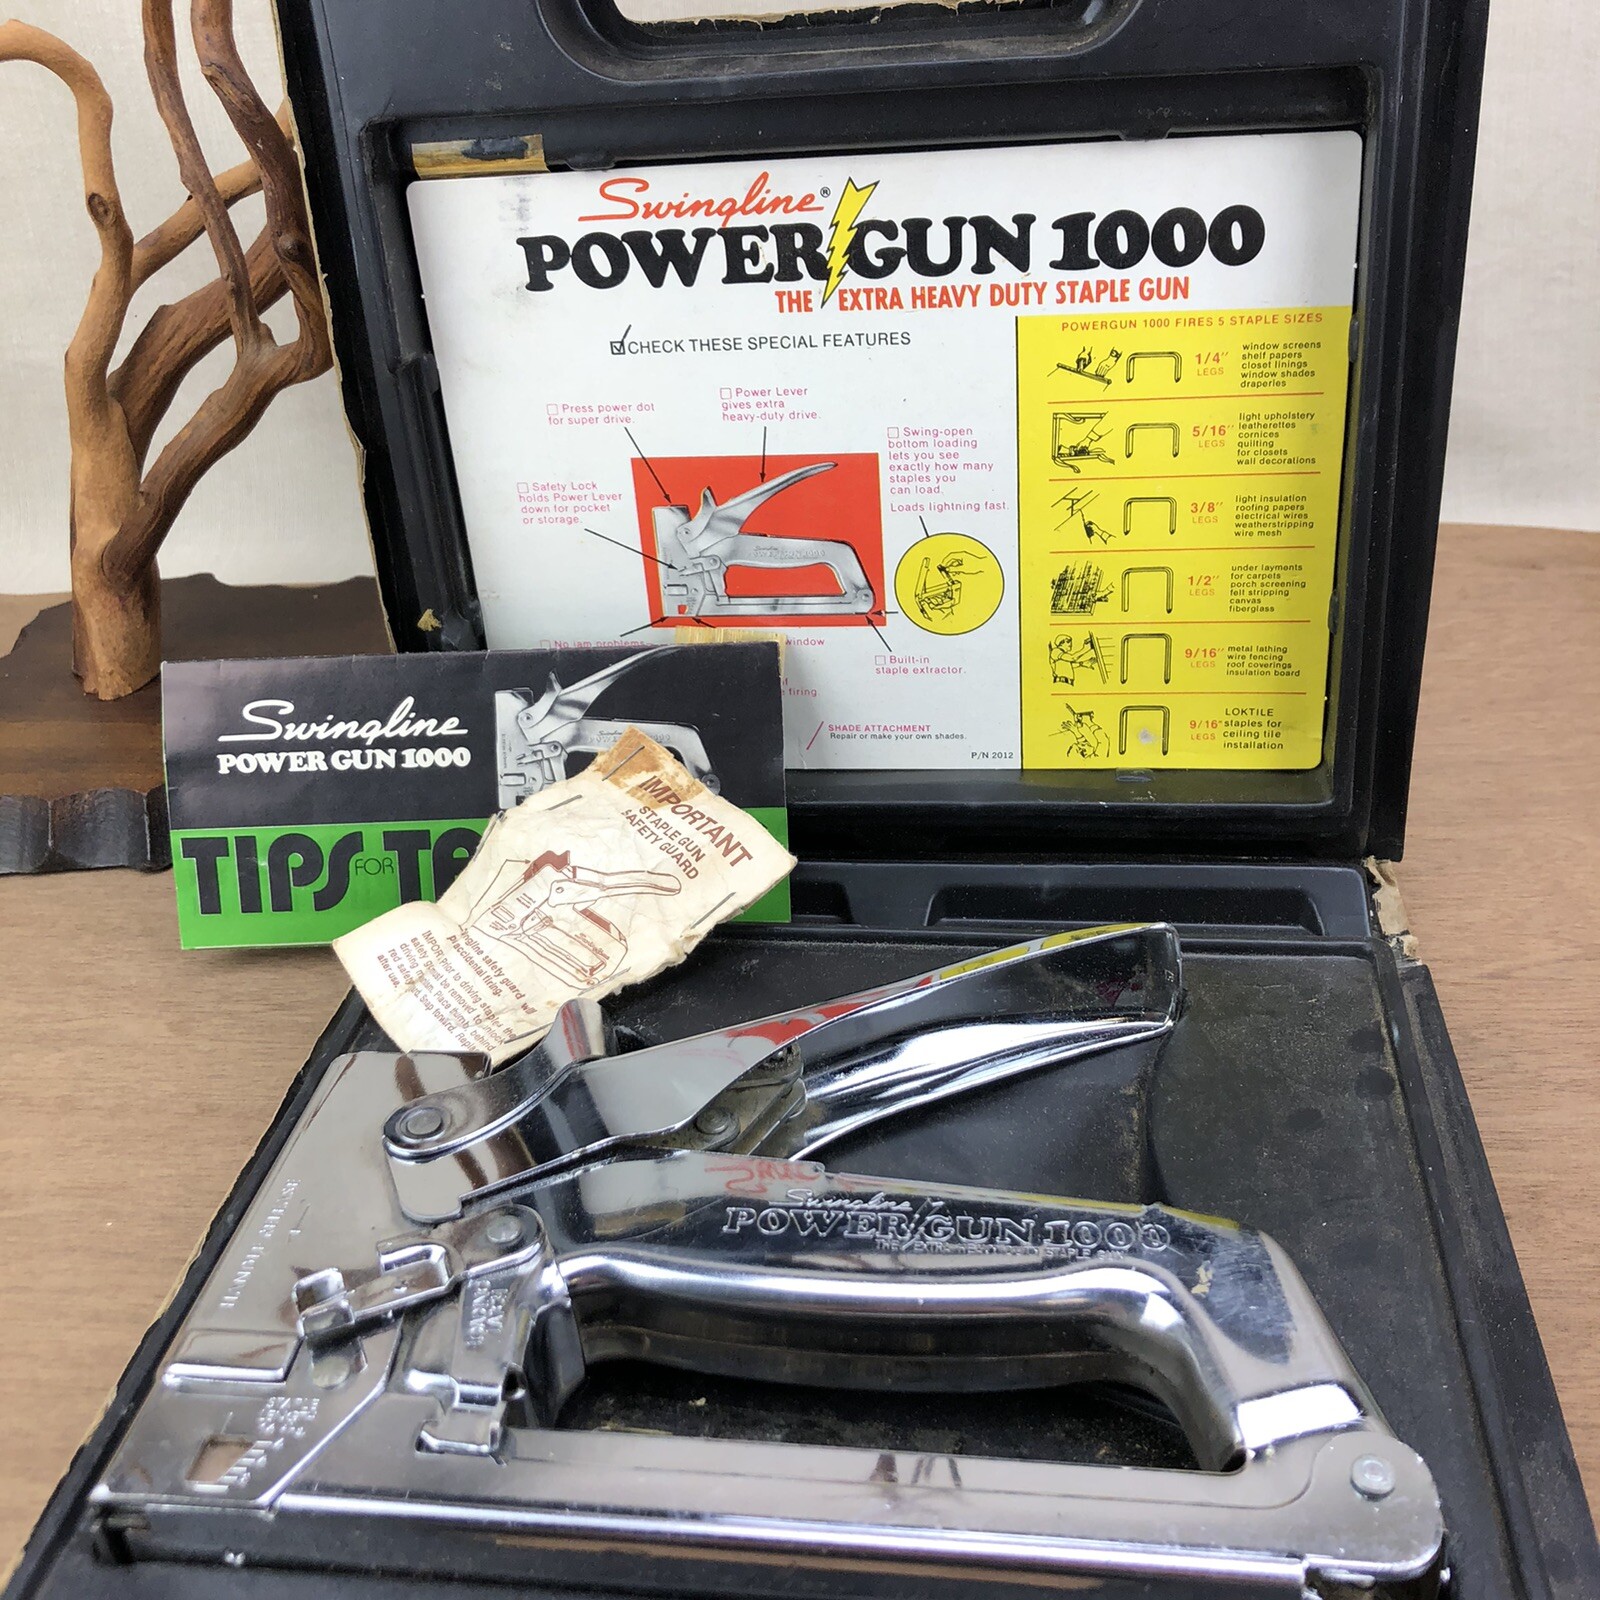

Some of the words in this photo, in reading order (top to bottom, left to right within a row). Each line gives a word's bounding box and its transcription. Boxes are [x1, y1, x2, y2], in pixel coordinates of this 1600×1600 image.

[516, 222, 830, 291] POWER
[848, 214, 1036, 279] GUN
[1049, 205, 1265, 271] 1000
[775, 290, 813, 313] THE
[838, 287, 900, 311] EXTRA
[911, 285, 981, 309] HEAVY
[990, 282, 1047, 307] DUTY
[1056, 278, 1131, 304] STAPLE
[1139, 276, 1189, 300] GUN
[1062, 320, 1137, 332] POWERGUN
[1143, 318, 1170, 328] 1000
[1176, 317, 1213, 327] FIRES
[1218, 317, 1224, 326] 5
[1230, 314, 1279, 325] STAPLE
[1284, 313, 1323, 324] SIZES
[628, 340, 685, 354] CHECK
[689, 337, 743, 352] THESE
[748, 335, 818, 350] SPECIAL
[823, 332, 911, 347] FEATURES
[1242, 342, 1279, 350] window
[1283, 341, 1321, 349] screens
[1242, 351, 1266, 360] shelf
[1269, 351, 1302, 361] papers
[1241, 361, 1271, 369] closet
[1275, 360, 1308, 369] linings
[1197, 367, 1224, 376] LEGS
[1241, 371, 1277, 379] window
[1281, 369, 1315, 378] shades
[1240, 380, 1286, 388] draperies
[735, 388, 772, 398] Power
[776, 386, 808, 396] Lever
[562, 404, 594, 413] Press
[598, 403, 632, 413] power
[637, 402, 655, 411] dot
[722, 400, 751, 411] gives
[756, 399, 785, 409] extra
[548, 415, 563, 425] for
[568, 416, 599, 426] super
[722, 410, 784, 422] heavy-duty
[789, 410, 821, 420] drive.
[1239, 412, 1261, 421] light
[1264, 412, 1315, 421] upholstery
[1239, 421, 1296, 430] leatherettes
[903, 427, 973, 438] Swing-open
[1238, 430, 1279, 438] cornices
[888, 440, 929, 448] bottom
[934, 439, 978, 449] loading
[1199, 440, 1225, 448] LEGS
[1237, 440, 1274, 448] quilting
[888, 451, 909, 460] lets
[914, 452, 934, 461] you
[1237, 448, 1250, 456] for
[1253, 448, 1288, 456] closets
[1237, 457, 1256, 465] wall
[889, 462, 930, 472] exactly
[934, 462, 958, 470] how
[963, 462, 993, 472] many
[889, 474, 931, 484] staples
[935, 474, 956, 484] you
[532, 482, 567, 492] Safety
[571, 481, 598, 490] Lock
[890, 486, 911, 495] can
[519, 494, 549, 502] holds
[553, 493, 588, 502] Power
[592, 493, 622, 501] Lever
[1235, 495, 1257, 504] light
[521, 505, 550, 513] down
[554, 505, 568, 513] for
[573, 504, 611, 513] pocket
[890, 502, 925, 512] Loads
[929, 501, 980, 512] lightning
[1236, 504, 1269, 512] roofing
[1235, 520, 1314, 529] weatherstripping
[1261, 564, 1303, 572] layments
[1247, 572, 1281, 581] carpets
[1260, 580, 1306, 588] screening
[1248, 589, 1289, 597] stripping
[1229, 605, 1275, 613] fiberglass
[785, 638, 825, 646] window
[1256, 645, 1288, 654] lathing
[890, 655, 930, 664] Built-in
[1249, 653, 1283, 662] fencing
[876, 666, 909, 675] staple
[1248, 662, 1292, 670] coverings
[1274, 669, 1300, 677] board
[1225, 707, 1274, 716] LOKTILE
[218, 695, 468, 745] Swingline
[1224, 719, 1263, 728] staples
[1266, 720, 1282, 728] for
[829, 724, 861, 732] SHADE
[864, 724, 931, 732] ATTACHMENT
[830, 732, 857, 740] Repair
[1223, 729, 1260, 739] ceiling
[1263, 730, 1281, 738] tile
[1223, 741, 1284, 750] installation
[971, 752, 990, 760] P/N
[992, 751, 1014, 760] 2012
[216, 751, 328, 774] POWER
[330, 748, 397, 770] GUN
[401, 747, 471, 769] 1000
[638, 775, 753, 867] IMPORTANT
[639, 805, 681, 842] STAPLE
[678, 836, 706, 863] GUN
[621, 809, 663, 845] SAFETY
[659, 842, 699, 880] GUARD
[181, 831, 364, 915] TIPS
[355, 857, 394, 875] FOR
[482, 954, 503, 980] safety
[499, 974, 525, 1001] guard
[520, 1001, 537, 1015] will
[722, 1207, 911, 1239] POWER
[920, 1215, 1034, 1246] GUN
[1044, 1220, 1170, 1250] 1000
